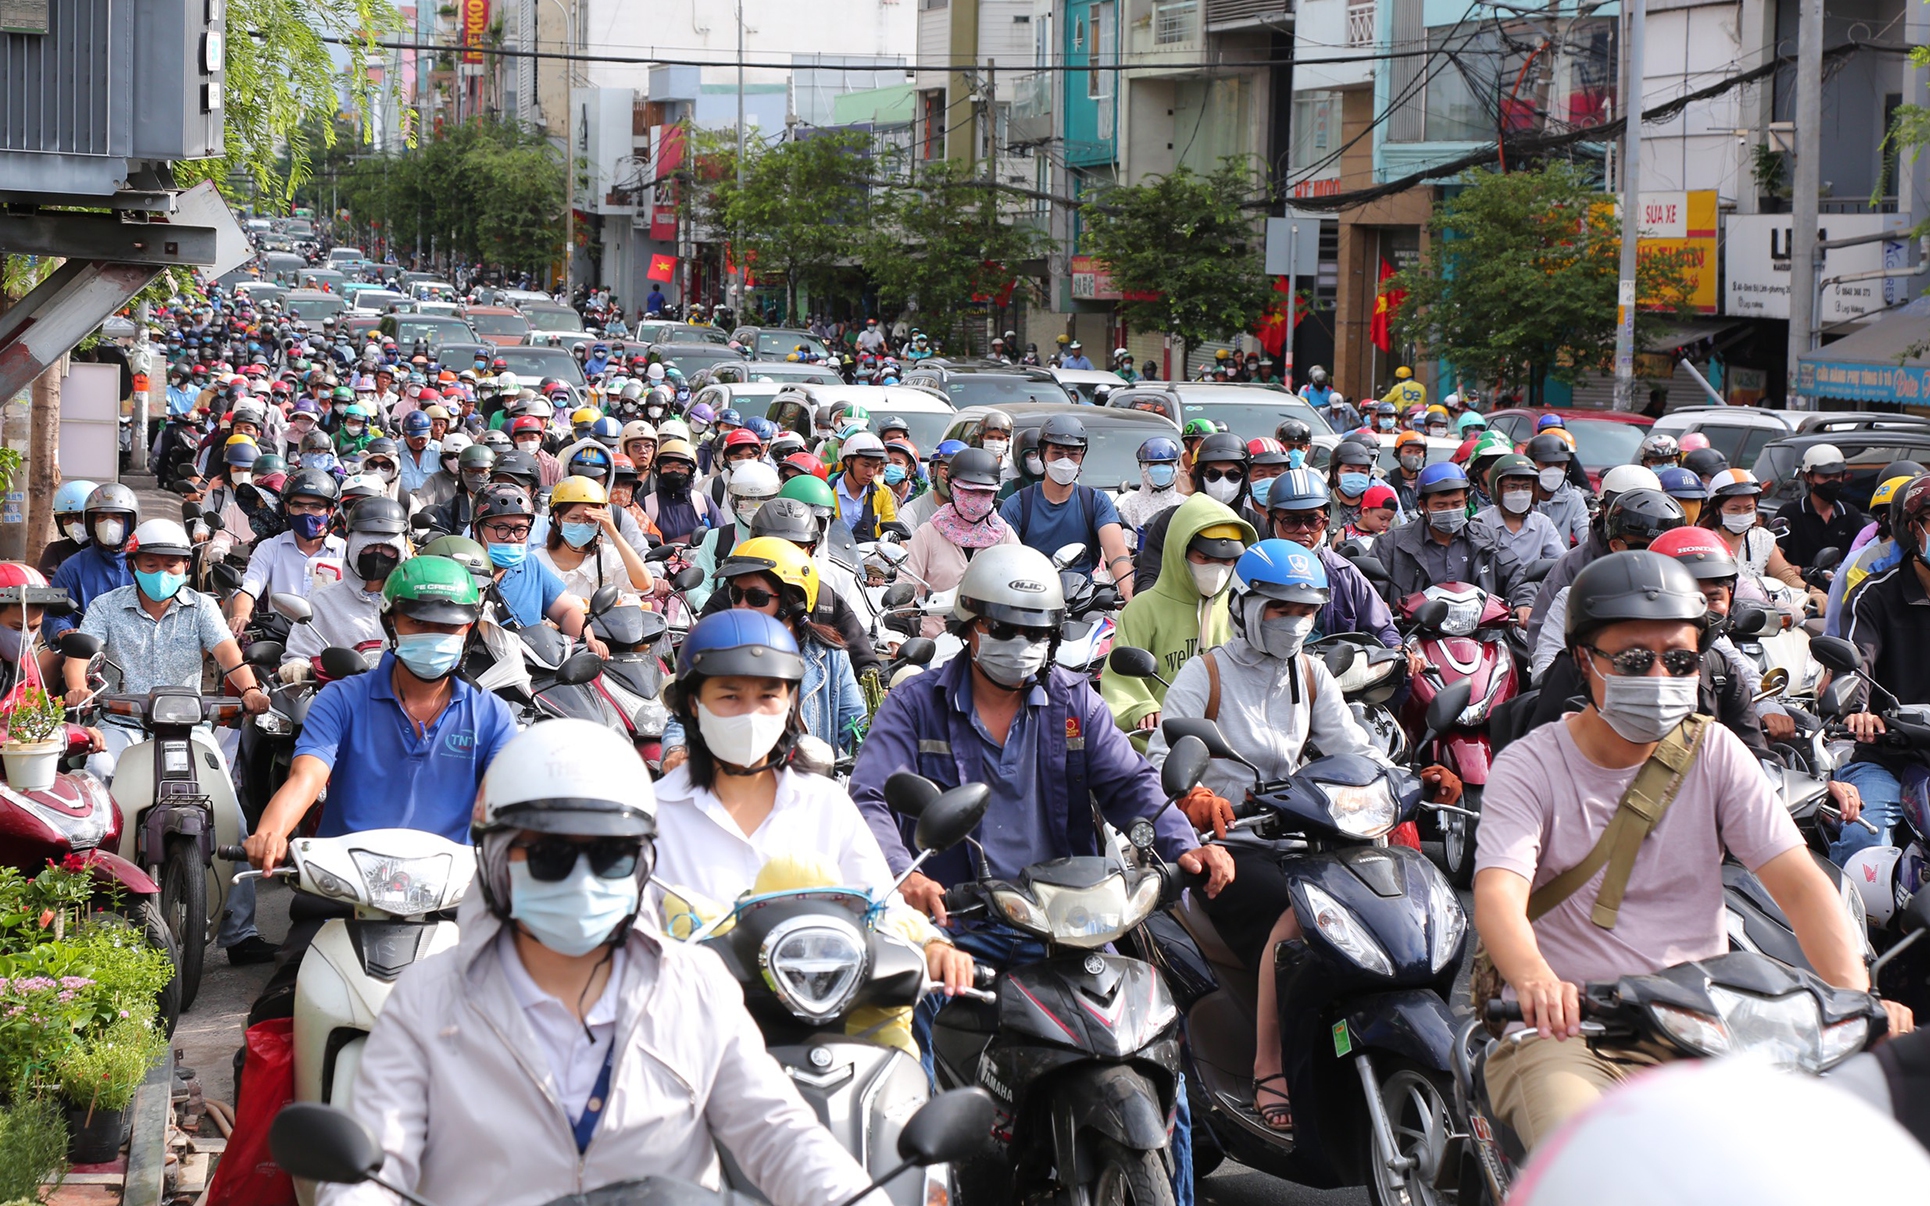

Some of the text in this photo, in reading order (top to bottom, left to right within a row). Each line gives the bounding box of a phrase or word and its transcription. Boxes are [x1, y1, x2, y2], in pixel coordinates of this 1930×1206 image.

[1665, 204, 1677, 224] XE
[1402, 385, 1422, 402] be
[1681, 475, 1695, 485] ila
[1677, 546, 1722, 554] HONDA
[1014, 581, 1042, 591] HJC
[980, 1068, 1013, 1103] YAMAHA
